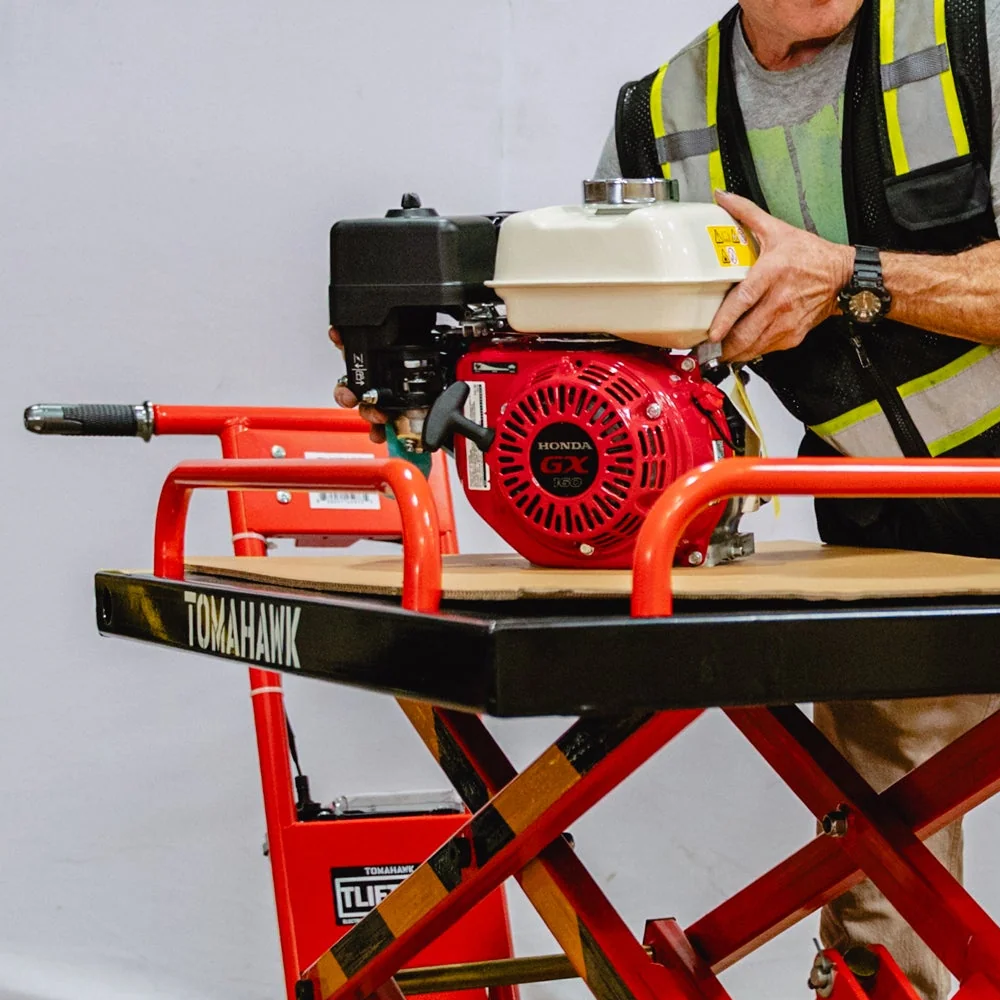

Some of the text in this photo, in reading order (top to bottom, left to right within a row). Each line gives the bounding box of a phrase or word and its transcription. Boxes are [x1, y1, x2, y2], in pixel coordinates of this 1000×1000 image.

[538, 441, 593, 450] HONDA
[541, 455, 589, 474] GX
[553, 477, 583, 488] 160
[184, 590, 301, 668] TOMAHAWK
[364, 865, 415, 875] TOMAHAWK
